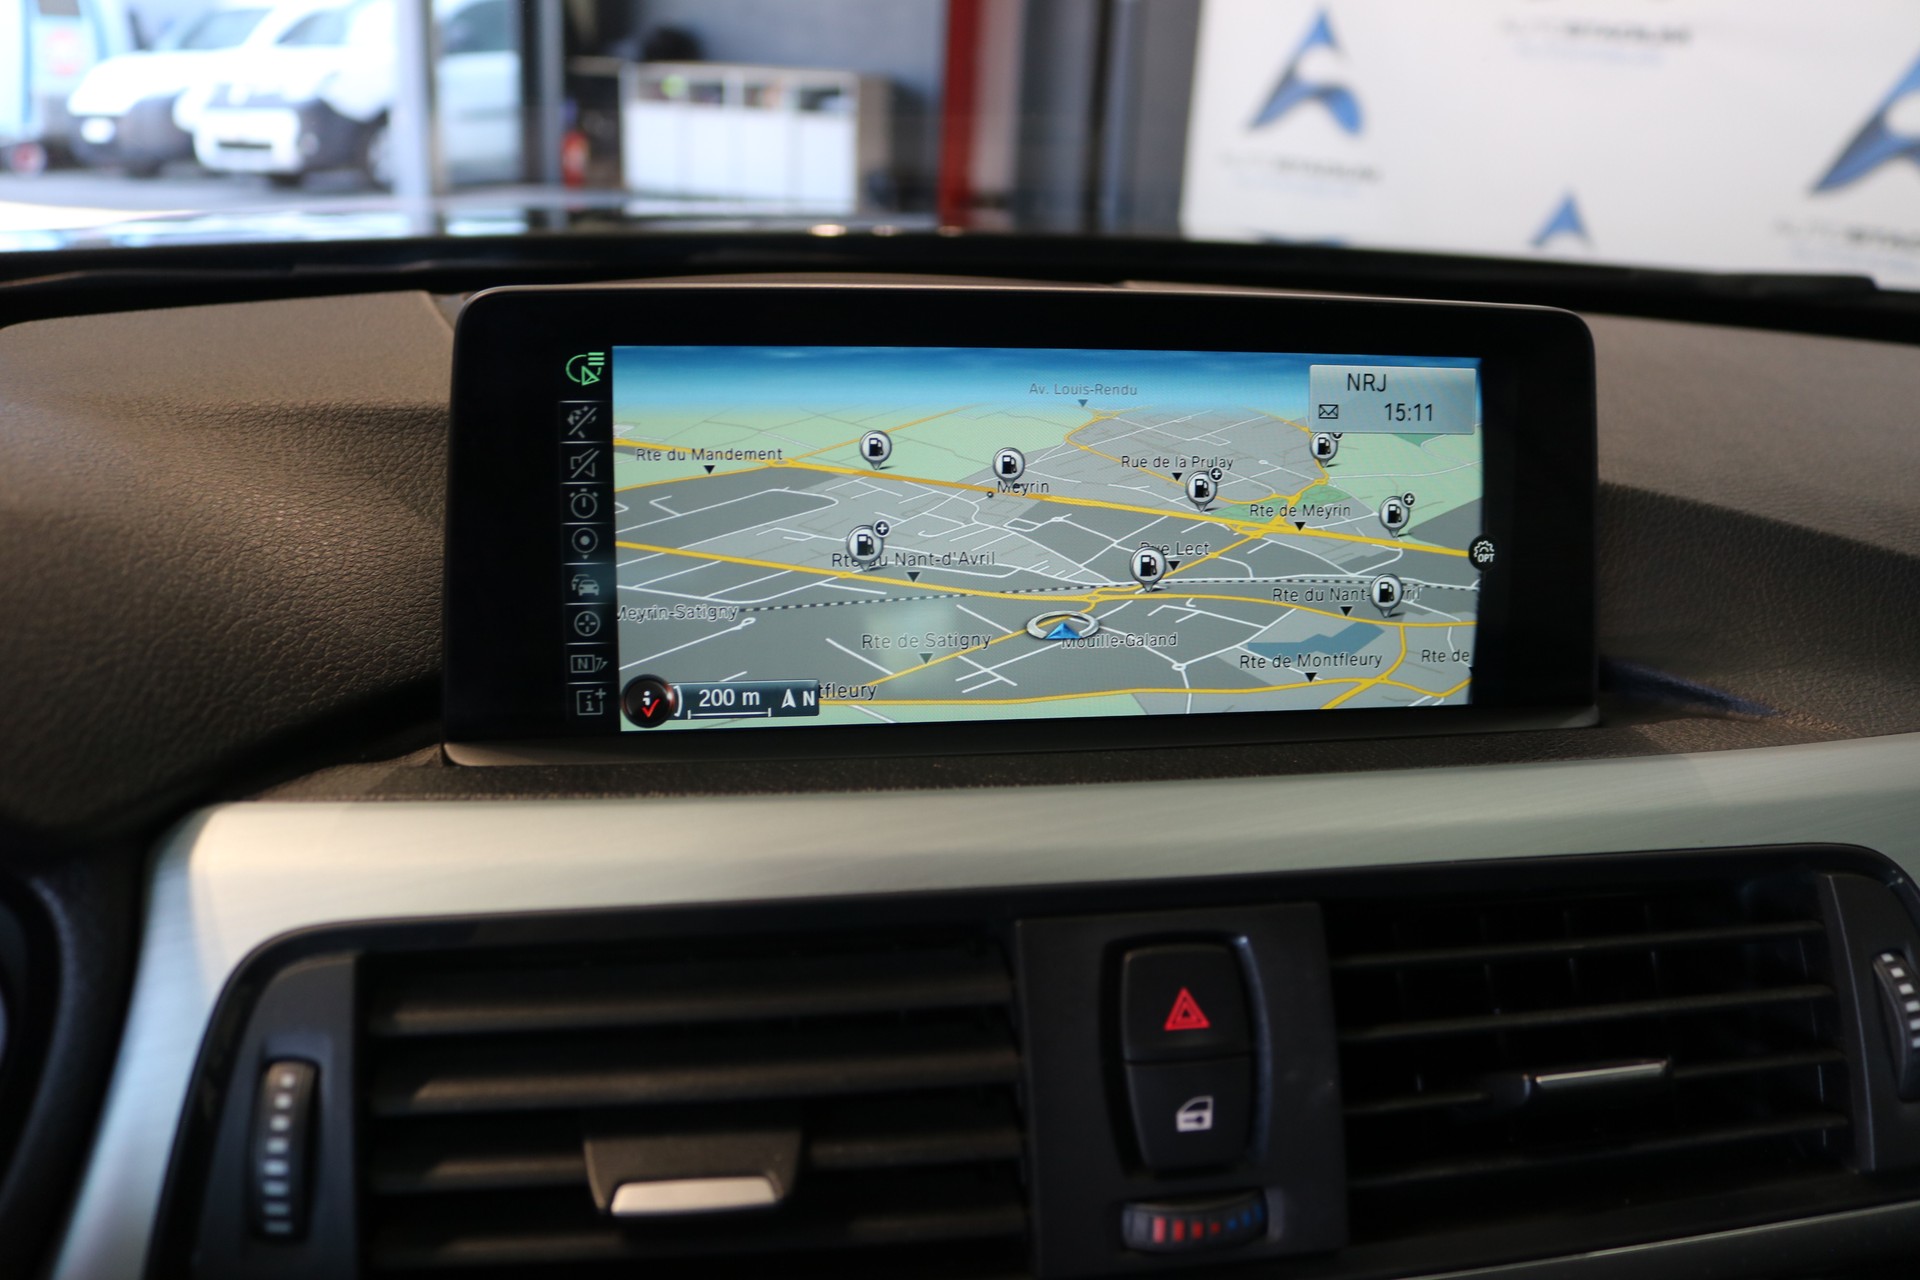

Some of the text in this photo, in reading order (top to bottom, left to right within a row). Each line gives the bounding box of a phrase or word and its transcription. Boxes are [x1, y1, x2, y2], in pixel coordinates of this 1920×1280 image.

[1029, 383, 1138, 396] Av. Louis-Rendu
[1347, 373, 1387, 392] NRJ
[1384, 403, 1433, 422] 15:11
[636, 448, 783, 461] Rte du Mandement
[1121, 455, 1234, 470] Rue de la Prulay
[997, 480, 1050, 496] Meyrin
[1250, 504, 1350, 519] Rte de Meyrin
[1176, 541, 1210, 556] Lect
[869, 554, 888, 567] u
[895, 551, 996, 567] Nant-d'Avril
[1477, 553, 1495, 563] OPT
[1273, 588, 1298, 601] Rte
[1304, 587, 1324, 601] du
[861, 632, 991, 650] Rte de Satigny
[1061, 633, 1178, 648] Mouille-Galand
[1239, 653, 1383, 669] Rte de Montfleury
[1421, 649, 1470, 662] Rte de
[699, 690, 760, 707] 200 m
[802, 690, 815, 707] N
